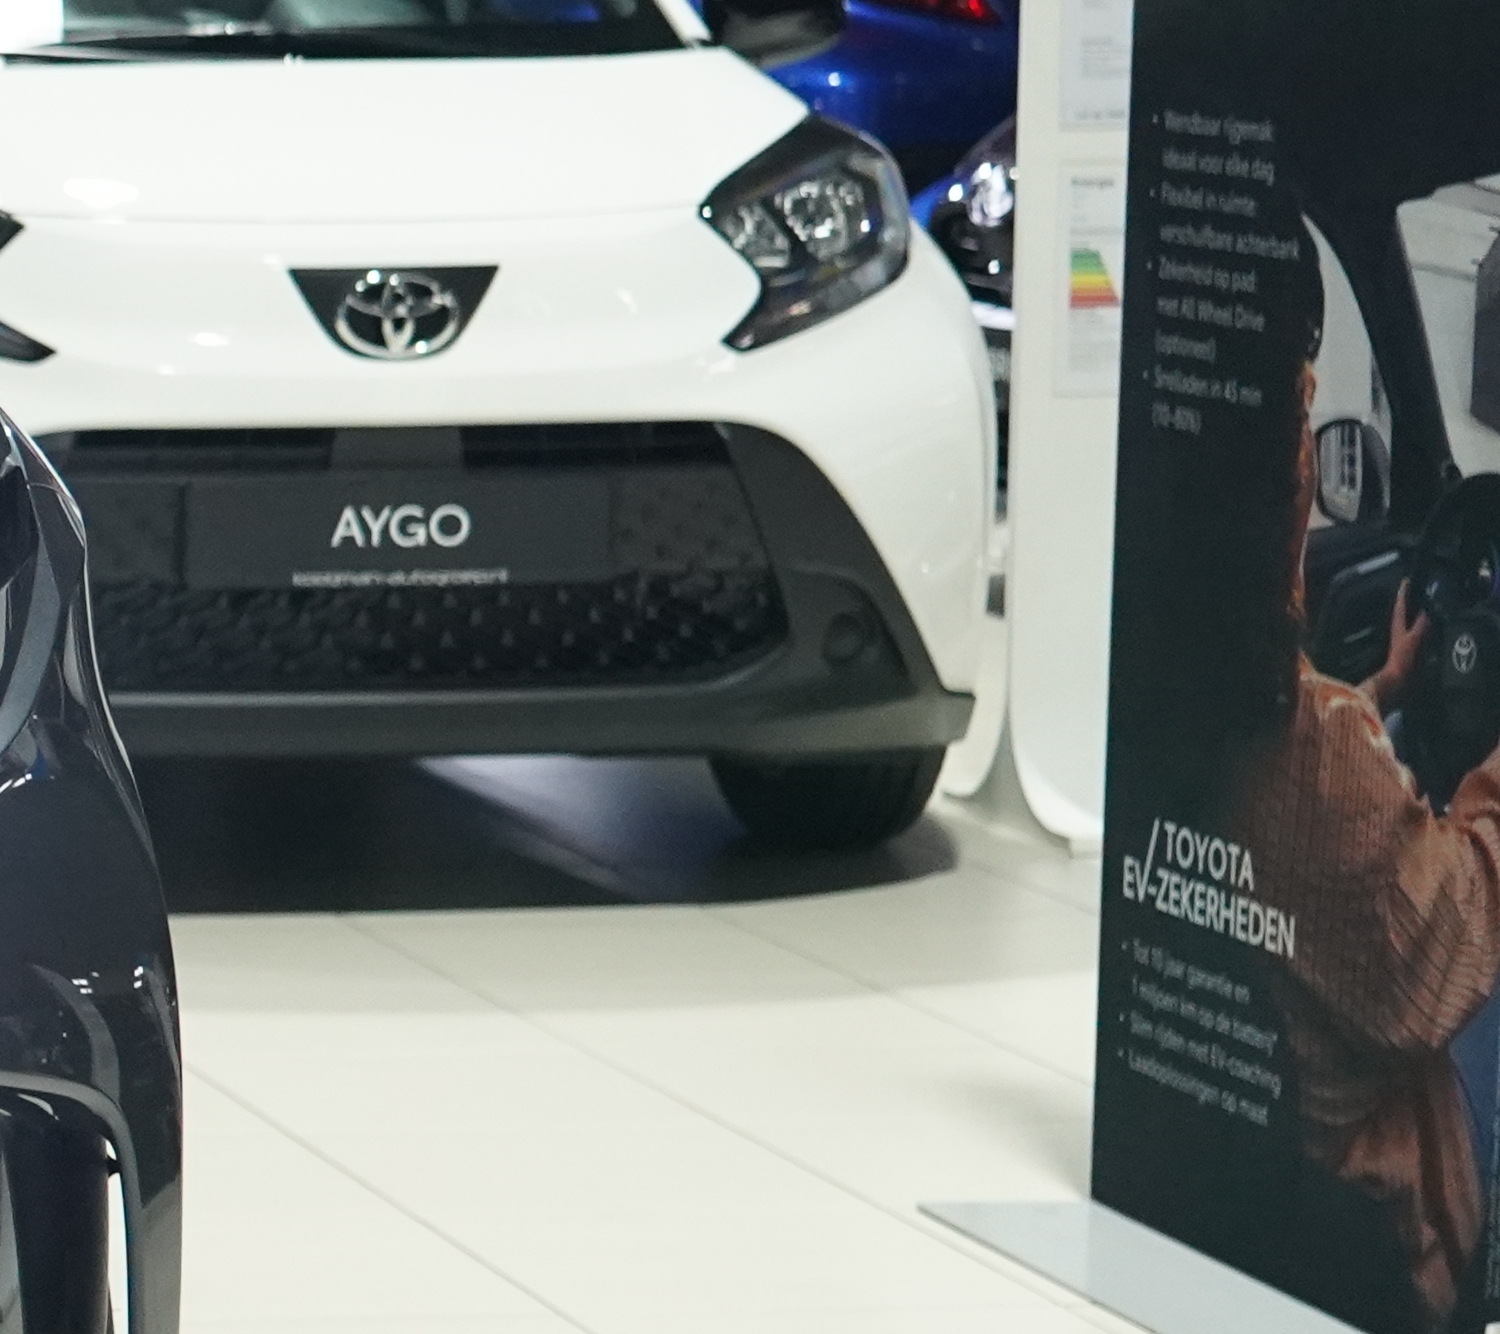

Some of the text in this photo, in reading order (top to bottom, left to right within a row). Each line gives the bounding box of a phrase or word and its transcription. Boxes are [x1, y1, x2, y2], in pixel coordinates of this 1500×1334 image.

[331, 503, 471, 548] AYGO
[1122, 817, 1297, 960] EV-ZEKERHEDEN
[1163, 820, 1255, 892] TOYOTA
